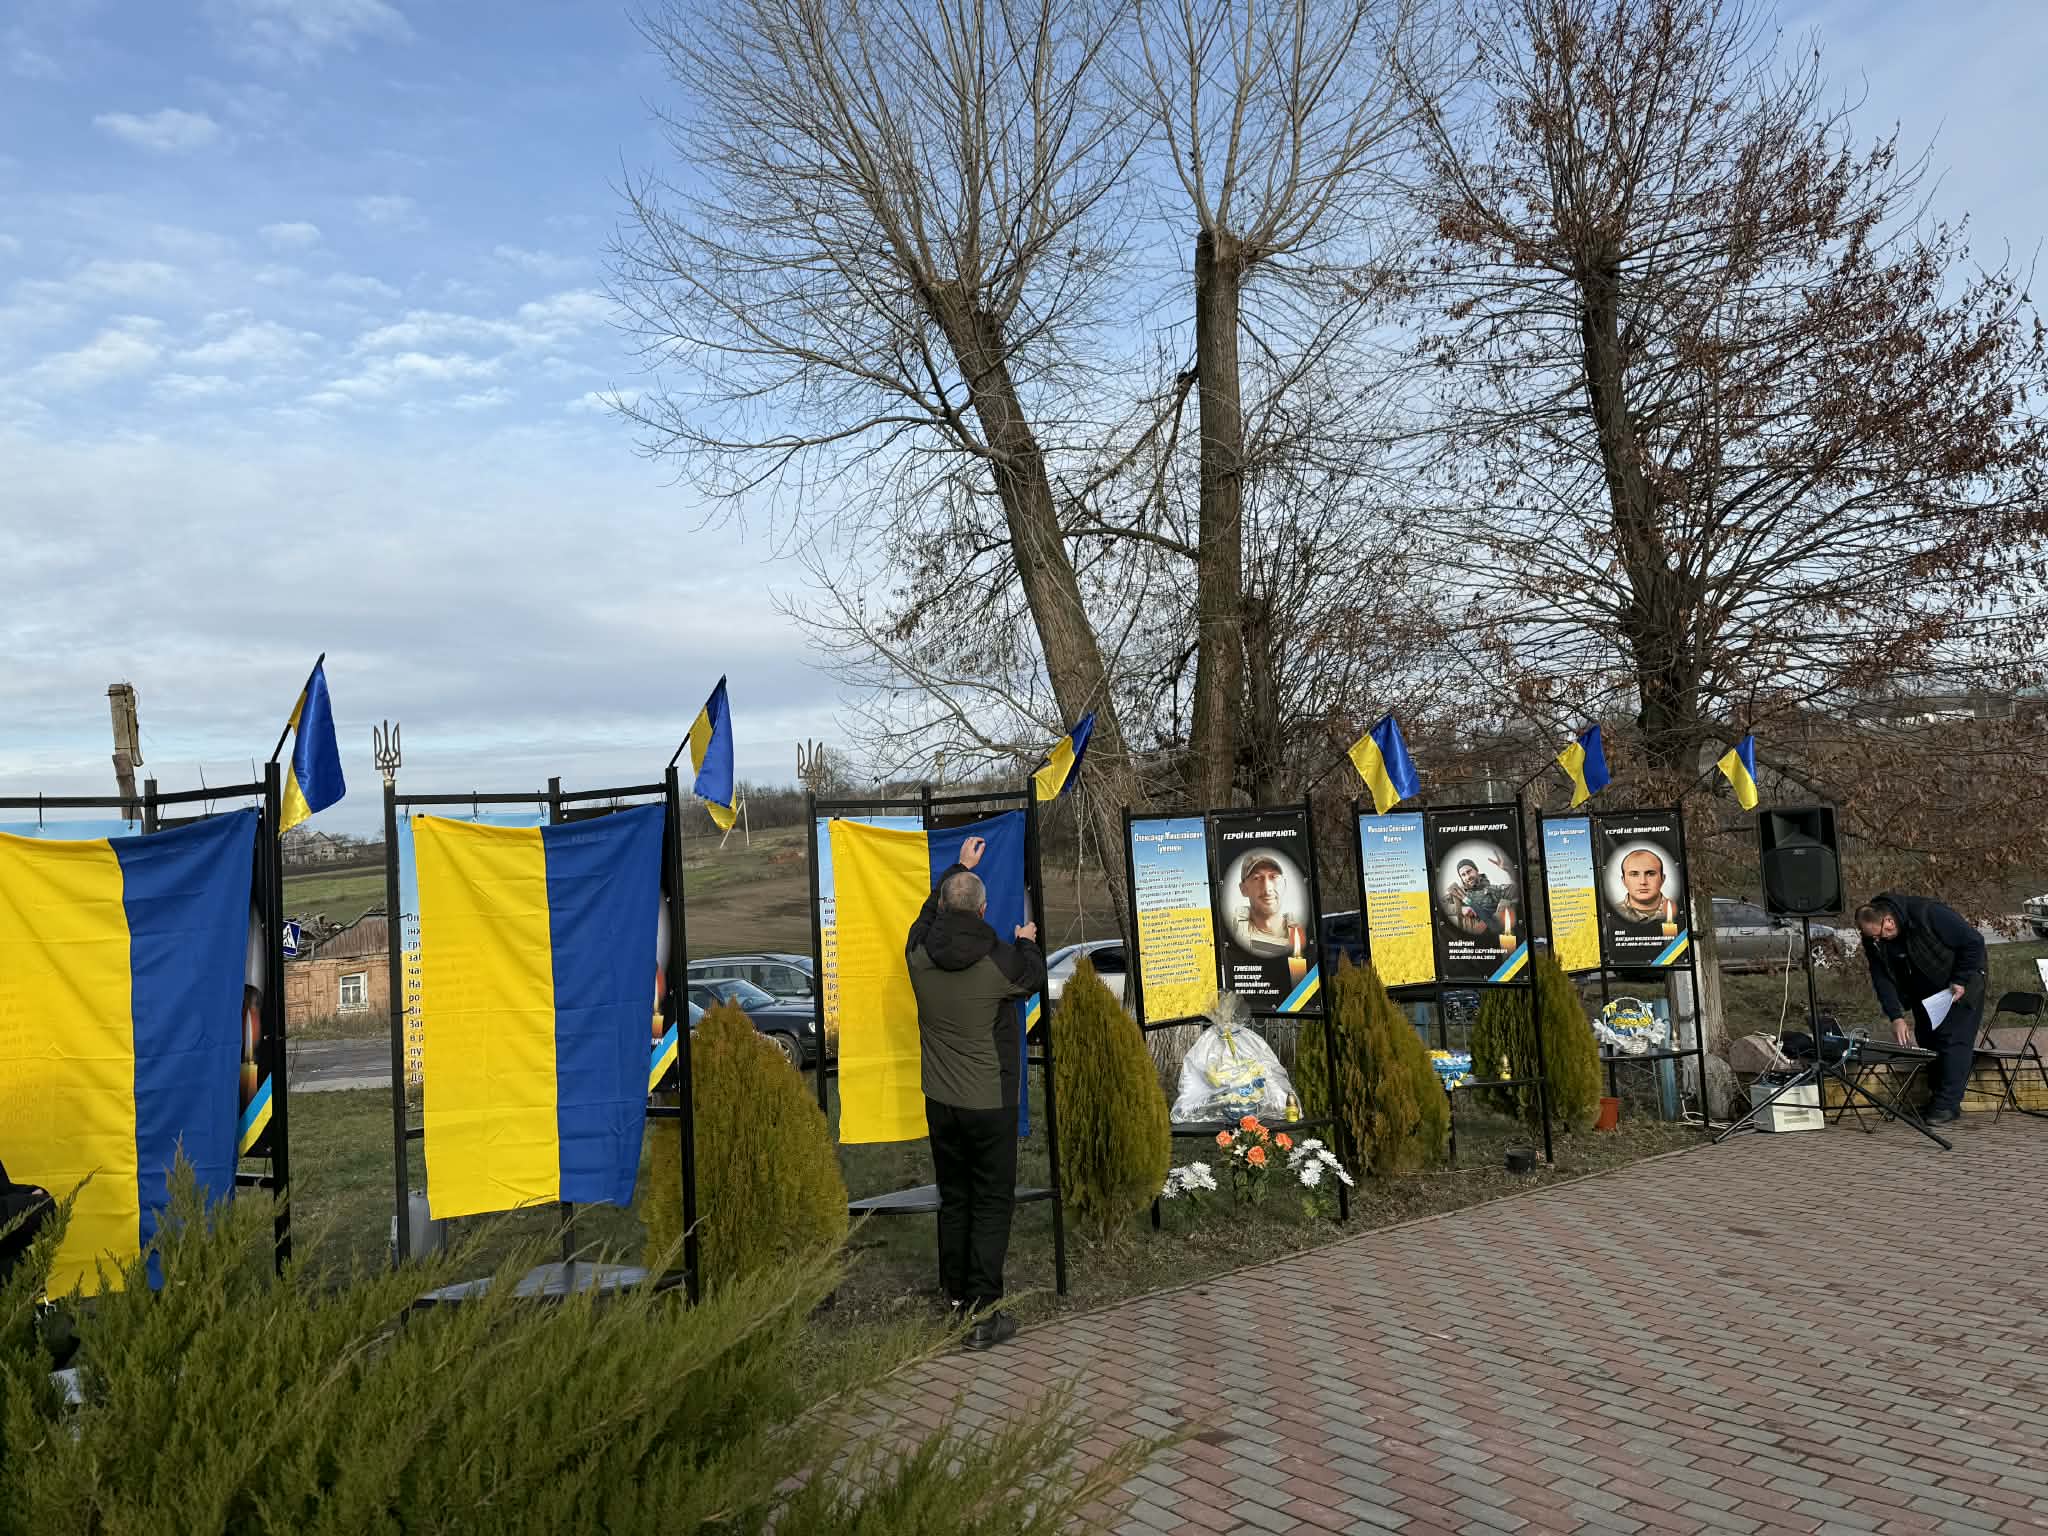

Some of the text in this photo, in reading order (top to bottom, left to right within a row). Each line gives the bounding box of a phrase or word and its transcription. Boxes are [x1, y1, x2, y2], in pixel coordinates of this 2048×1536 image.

[1223, 829, 1298, 841] ГЕРОЇ НЕ ВМИРАЮТЬ
